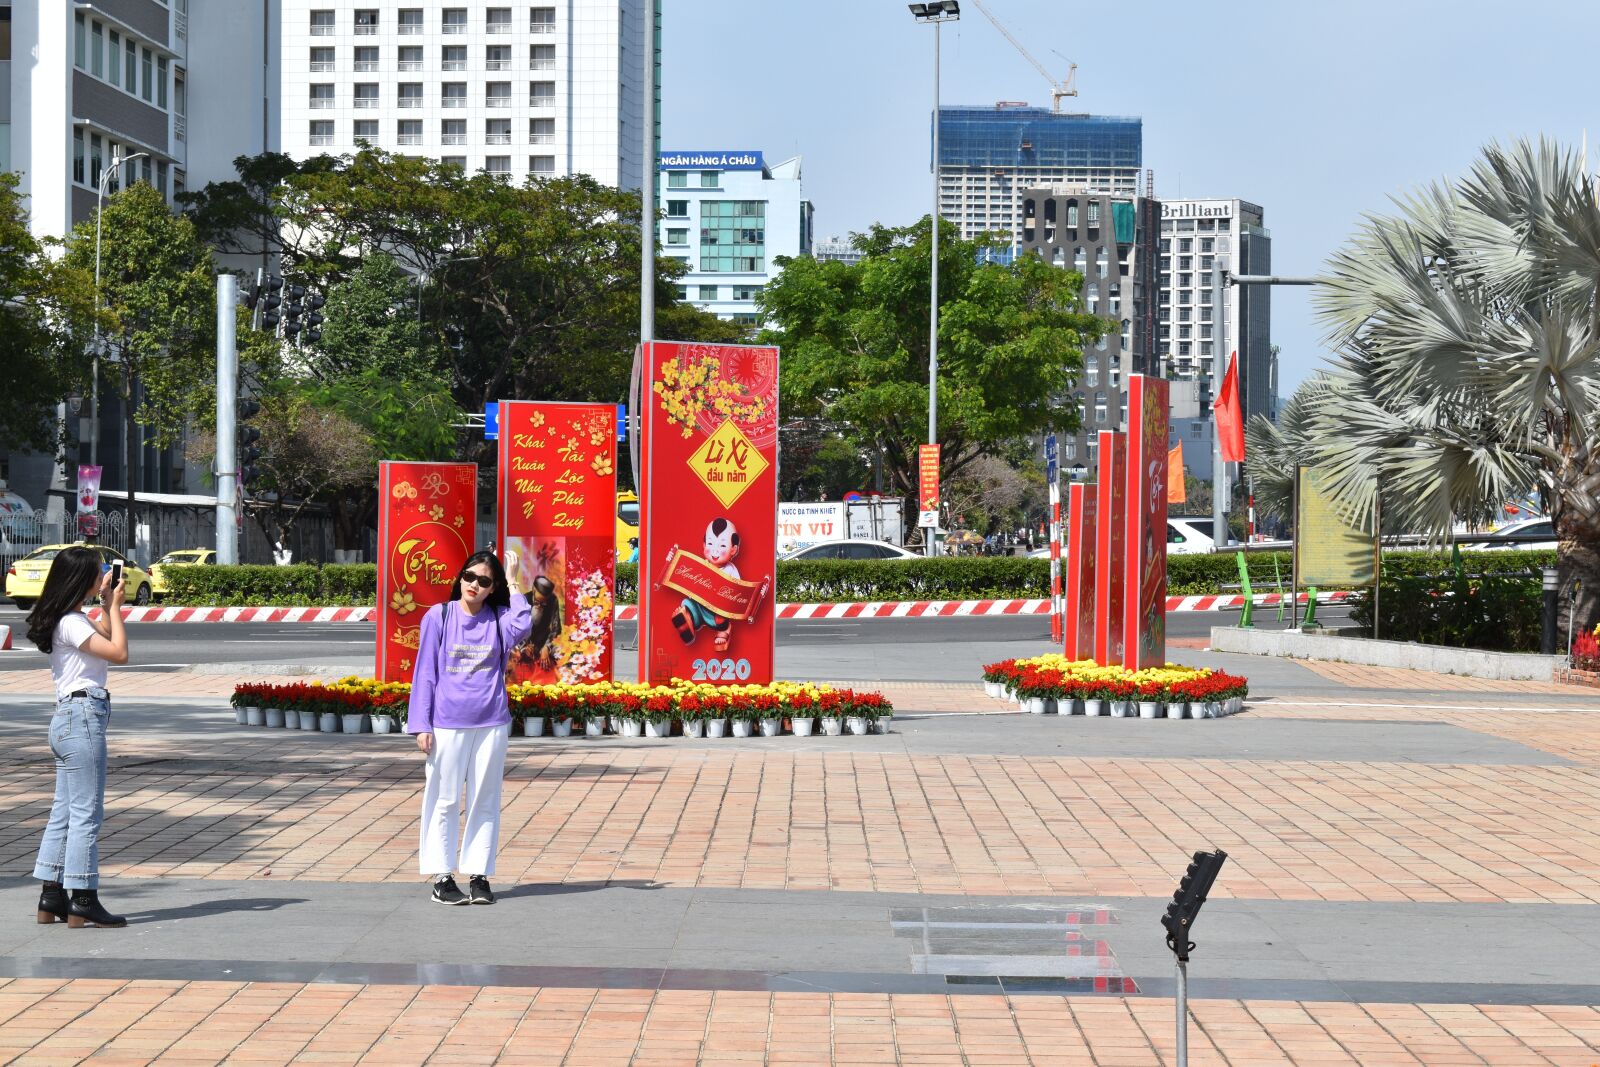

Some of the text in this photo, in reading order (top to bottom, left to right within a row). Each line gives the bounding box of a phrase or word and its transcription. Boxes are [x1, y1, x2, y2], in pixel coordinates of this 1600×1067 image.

[661, 154, 756, 166] NGÂN HÀNG Á CHÂU
[1161, 201, 1230, 218] Brilliant
[513, 433, 546, 449] Khai
[557, 447, 586, 462] Tài
[704, 437, 749, 470] Lì Xì
[512, 456, 545, 471] Xuân
[554, 469, 585, 486] Lộc
[727, 469, 747, 483] năm
[514, 478, 544, 493] Như
[552, 490, 585, 506] Phú
[522, 498, 537, 519] Ý
[552, 512, 585, 531] Quý
[692, 658, 751, 681] 2020
